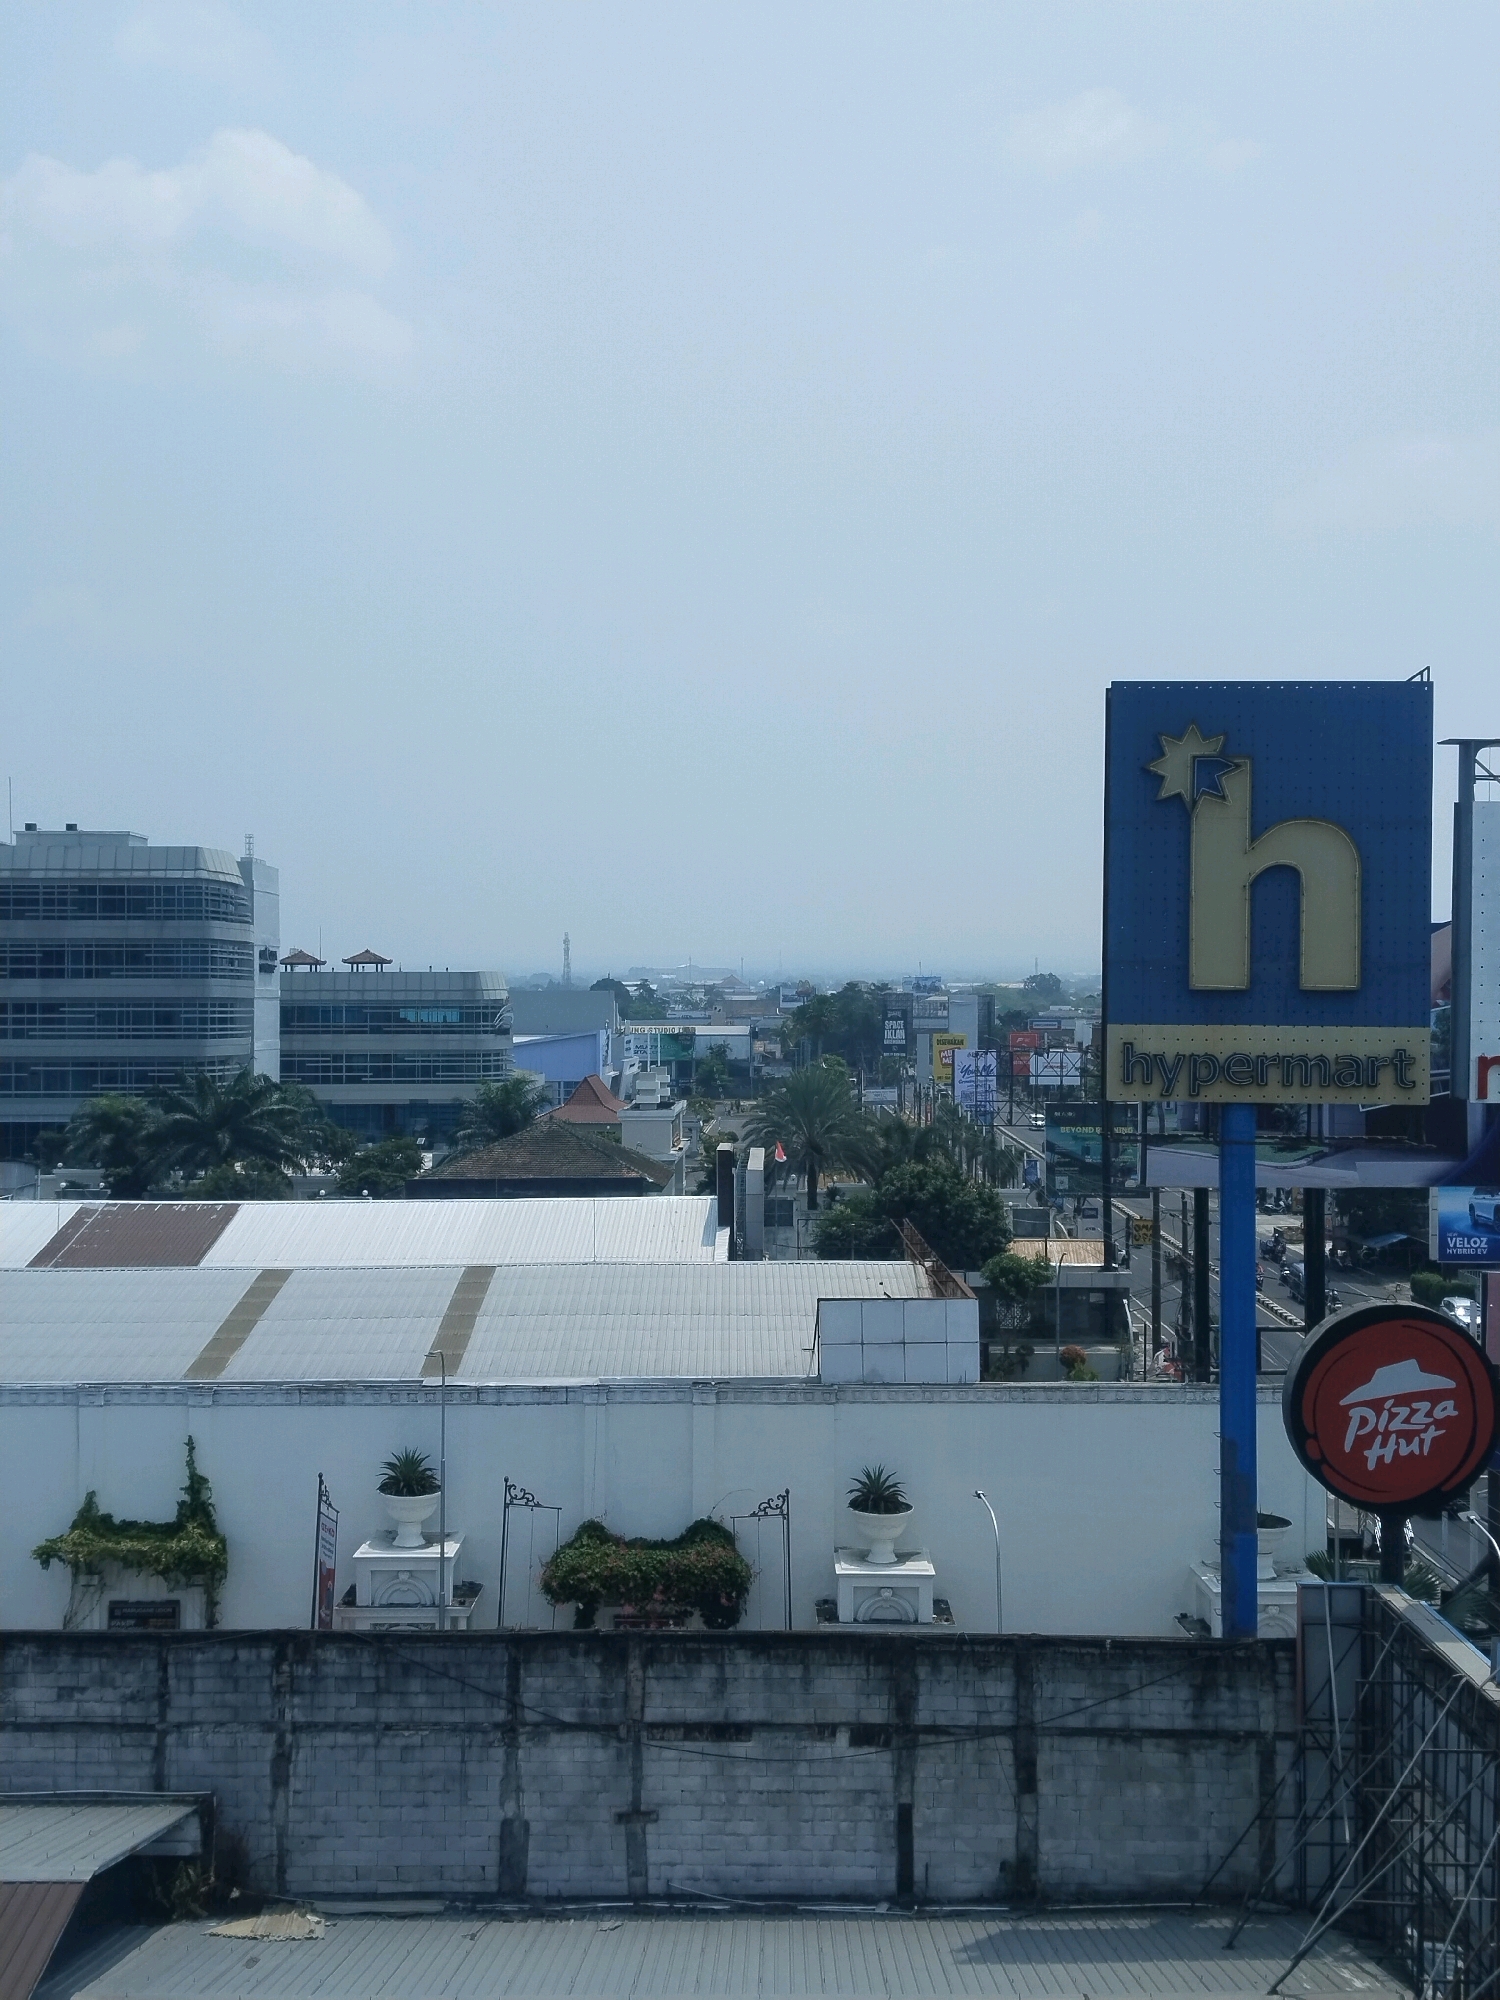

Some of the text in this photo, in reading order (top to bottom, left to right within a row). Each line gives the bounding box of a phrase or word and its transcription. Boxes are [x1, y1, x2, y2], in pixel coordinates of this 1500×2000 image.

[884, 1020, 904, 1029] SPACE
[884, 1029, 905, 1039] IKLAN
[1122, 1042, 1416, 1096] hypermart
[1447, 1237, 1488, 1248] VELOZ
[1344, 1399, 1458, 1453] Pizza
[1363, 1425, 1446, 1470] Hut
